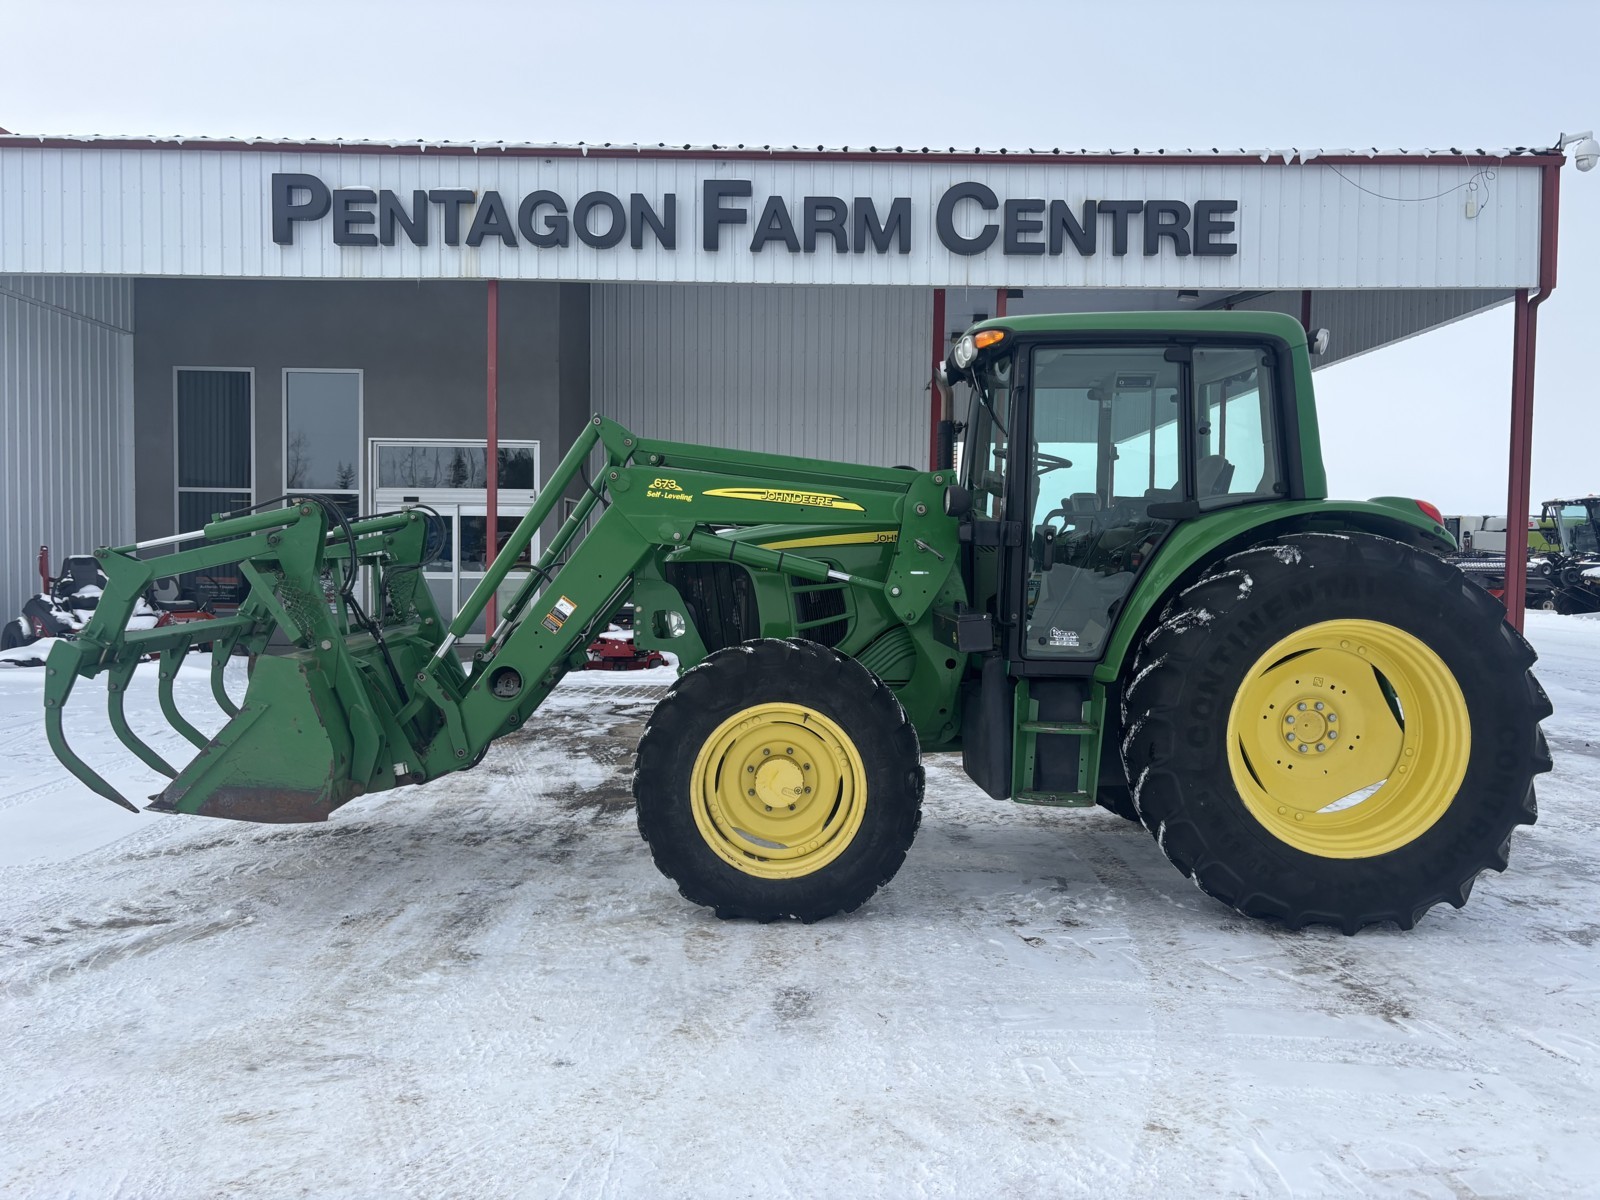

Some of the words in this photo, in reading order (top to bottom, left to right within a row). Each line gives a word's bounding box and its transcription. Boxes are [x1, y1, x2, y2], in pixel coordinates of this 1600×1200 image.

[272, 173, 676, 249] PENTAGON
[703, 179, 911, 254] FARM
[936, 181, 1238, 257] CENTRE
[654, 478, 677, 489] 673
[761, 490, 791, 503] JOHN
[793, 493, 833, 506] DEERE
